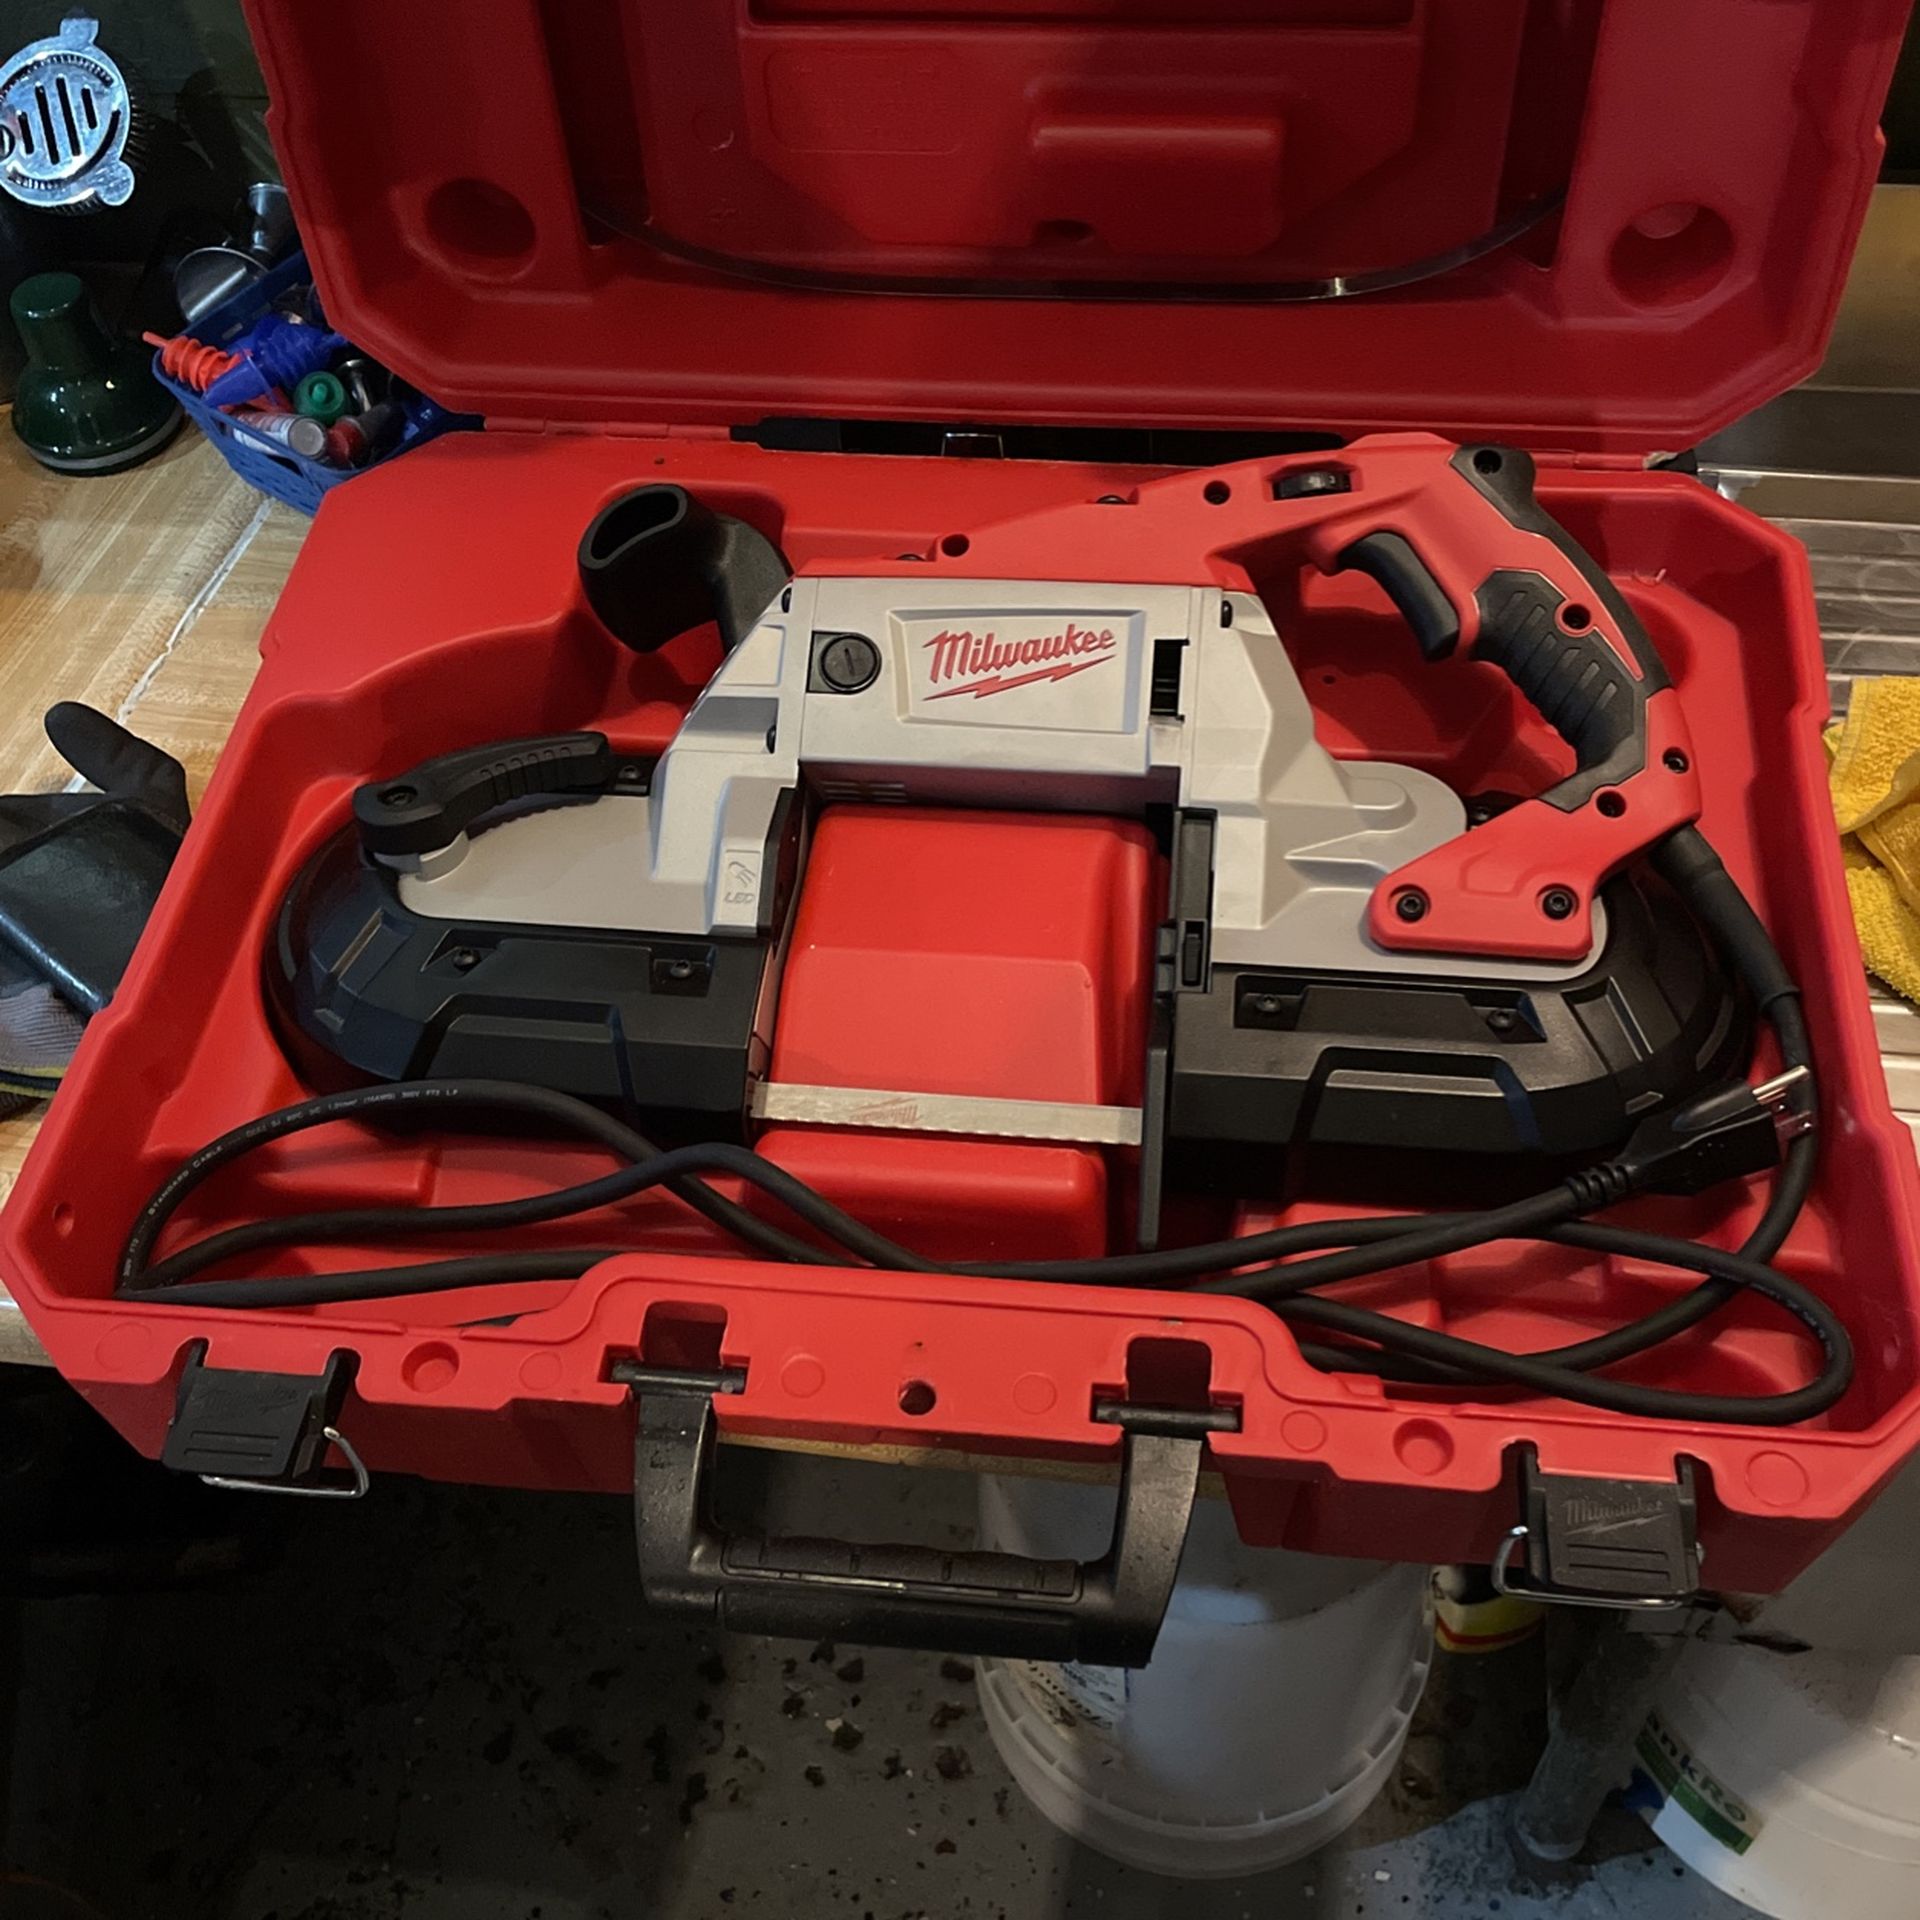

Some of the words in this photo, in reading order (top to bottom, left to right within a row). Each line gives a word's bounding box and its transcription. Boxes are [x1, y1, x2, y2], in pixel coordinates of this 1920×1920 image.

[922, 623, 1117, 684] Milwaukee
[724, 892, 756, 904] LED
[147, 1169, 190, 1216] STANDARD
[192, 1145, 223, 1169] CABLE
[1560, 1497, 1663, 1526] Milwaukee
